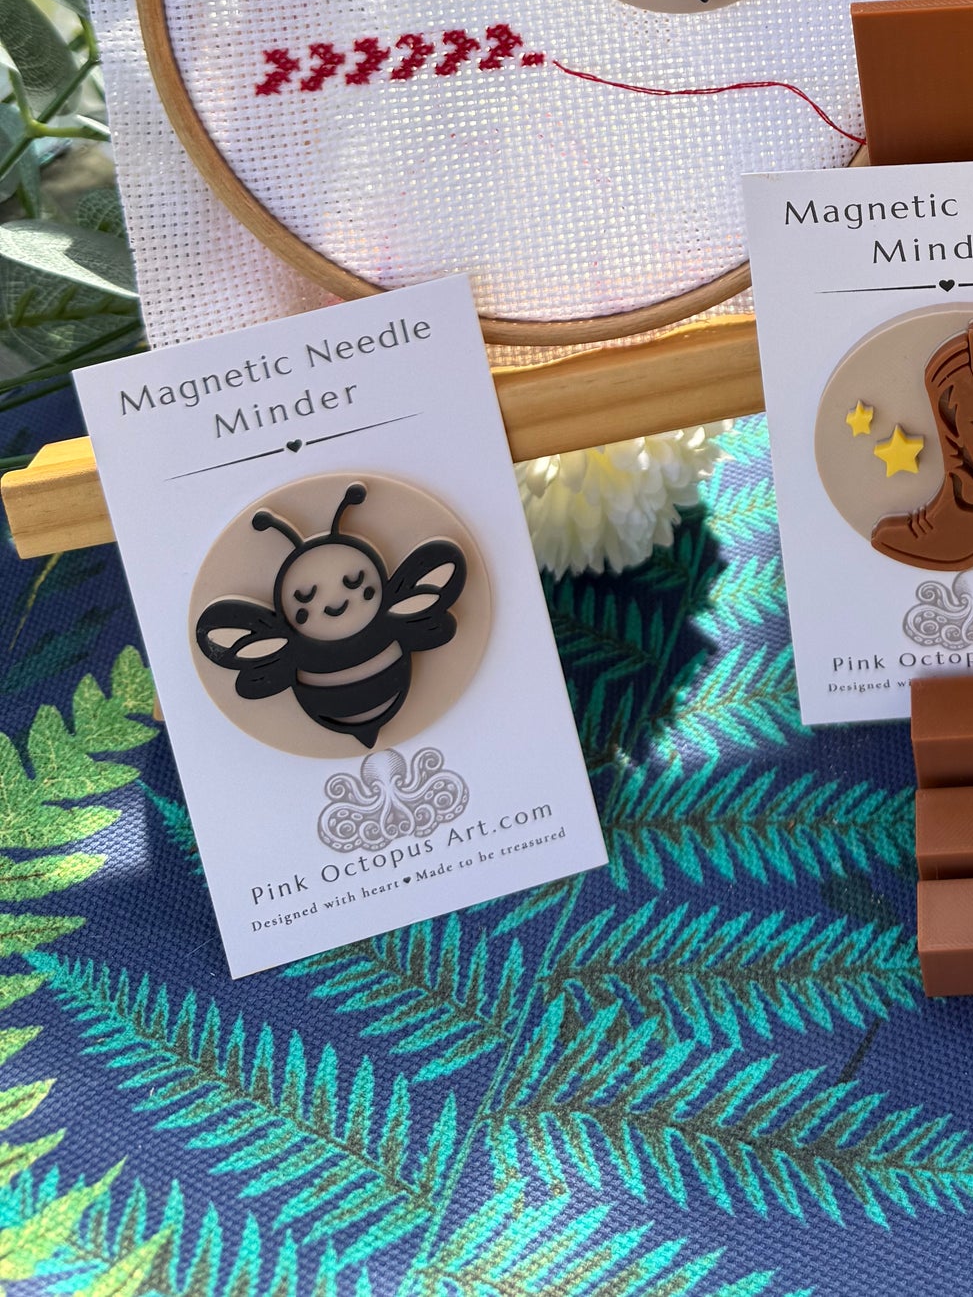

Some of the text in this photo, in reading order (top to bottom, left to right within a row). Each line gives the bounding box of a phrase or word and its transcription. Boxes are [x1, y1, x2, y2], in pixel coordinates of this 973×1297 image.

[785, 192, 958, 228] Magnetic
[120, 319, 432, 416] Magnetic Needle
[215, 384, 357, 438] Minder
[828, 679, 890, 694] Designed
[833, 653, 886, 672] Pink
[251, 804, 552, 905] Pink Octopus Art.com
[251, 827, 567, 932] Designed with heart Made to be treasured
